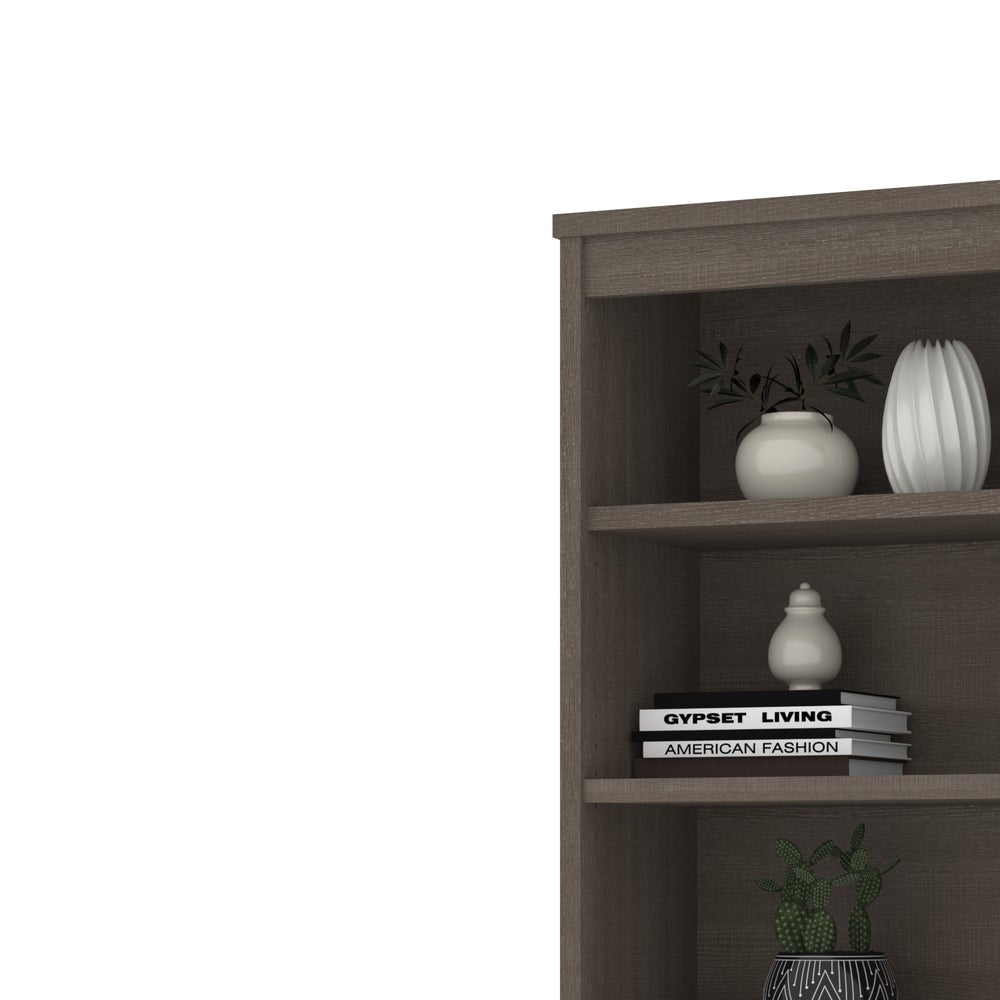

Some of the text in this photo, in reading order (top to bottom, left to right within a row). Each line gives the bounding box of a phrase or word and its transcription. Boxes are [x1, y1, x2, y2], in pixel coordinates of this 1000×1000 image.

[664, 710, 833, 724] GYPSET LIVING
[665, 741, 839, 755] AMERICAN FASHION
